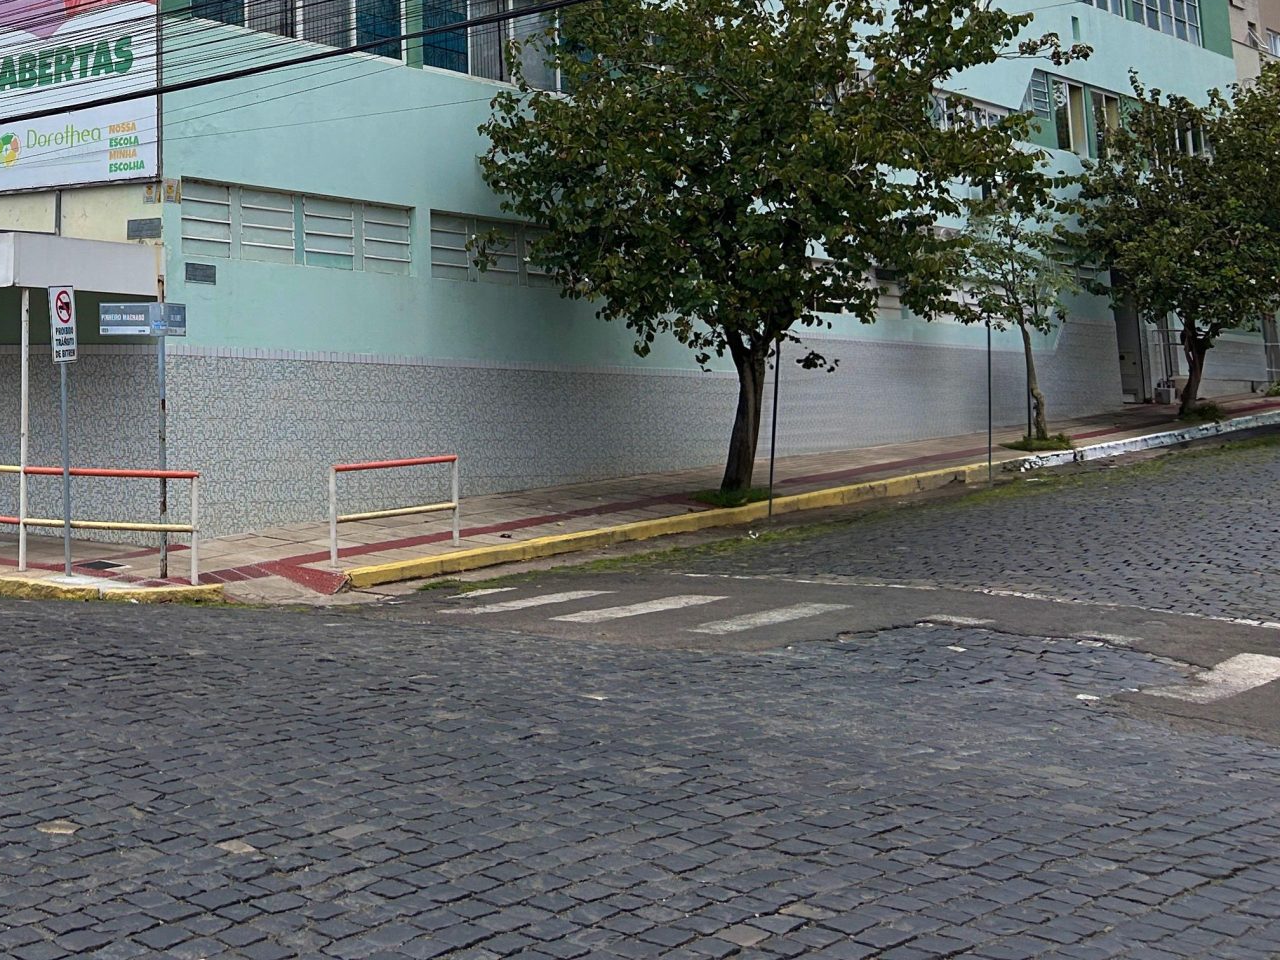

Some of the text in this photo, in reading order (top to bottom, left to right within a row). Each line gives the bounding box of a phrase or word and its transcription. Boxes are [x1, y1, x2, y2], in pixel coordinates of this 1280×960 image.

[108, 121, 137, 135] NOSSA
[26, 124, 101, 149] Dorothea
[109, 136, 139, 148] ESCOLA
[109, 148, 138, 161] MINHA
[109, 160, 145, 173] ESCOLHA
